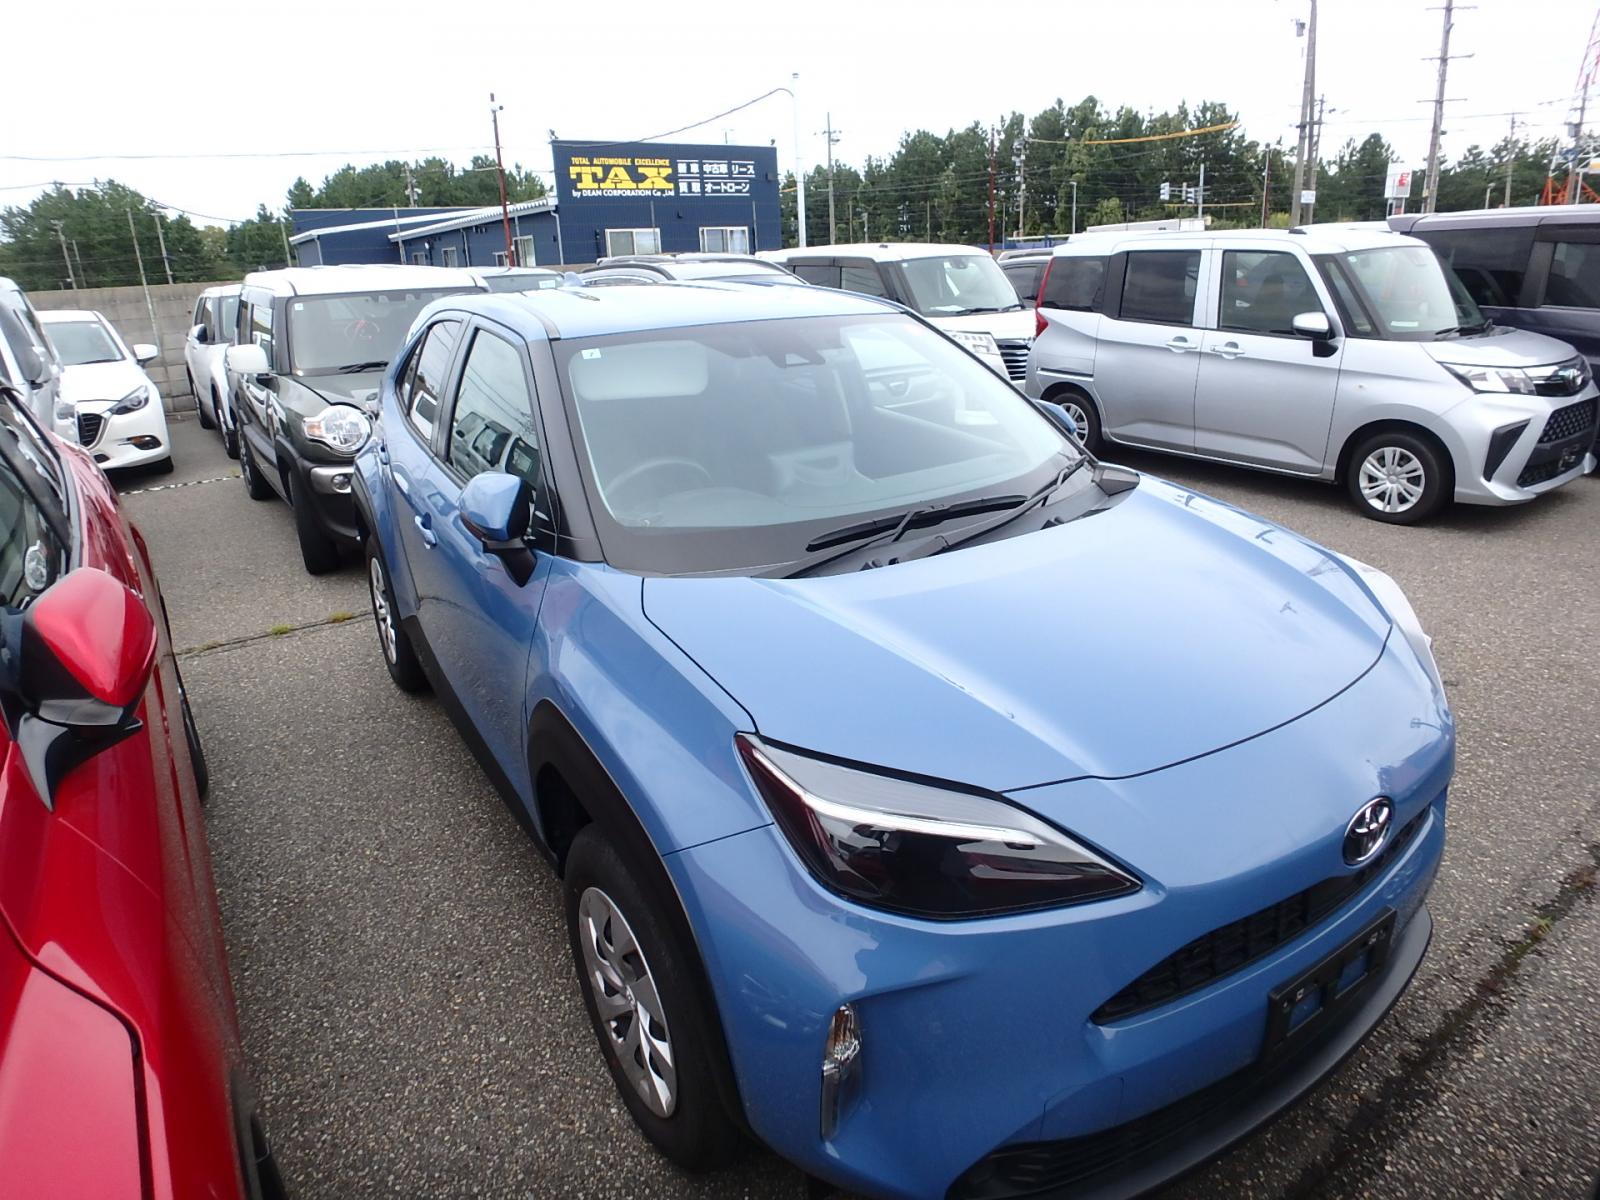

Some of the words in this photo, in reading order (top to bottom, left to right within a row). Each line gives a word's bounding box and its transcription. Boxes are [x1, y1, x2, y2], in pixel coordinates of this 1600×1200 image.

[571, 157, 590, 165] TOTAL
[593, 158, 631, 166] AUTOMOBILE
[635, 158, 670, 166] EXCELLENCE
[732, 165, 755, 174] リース
[570, 166, 674, 189] TAX
[704, 183, 750, 193] オートローン
[572, 190, 581, 198] by
